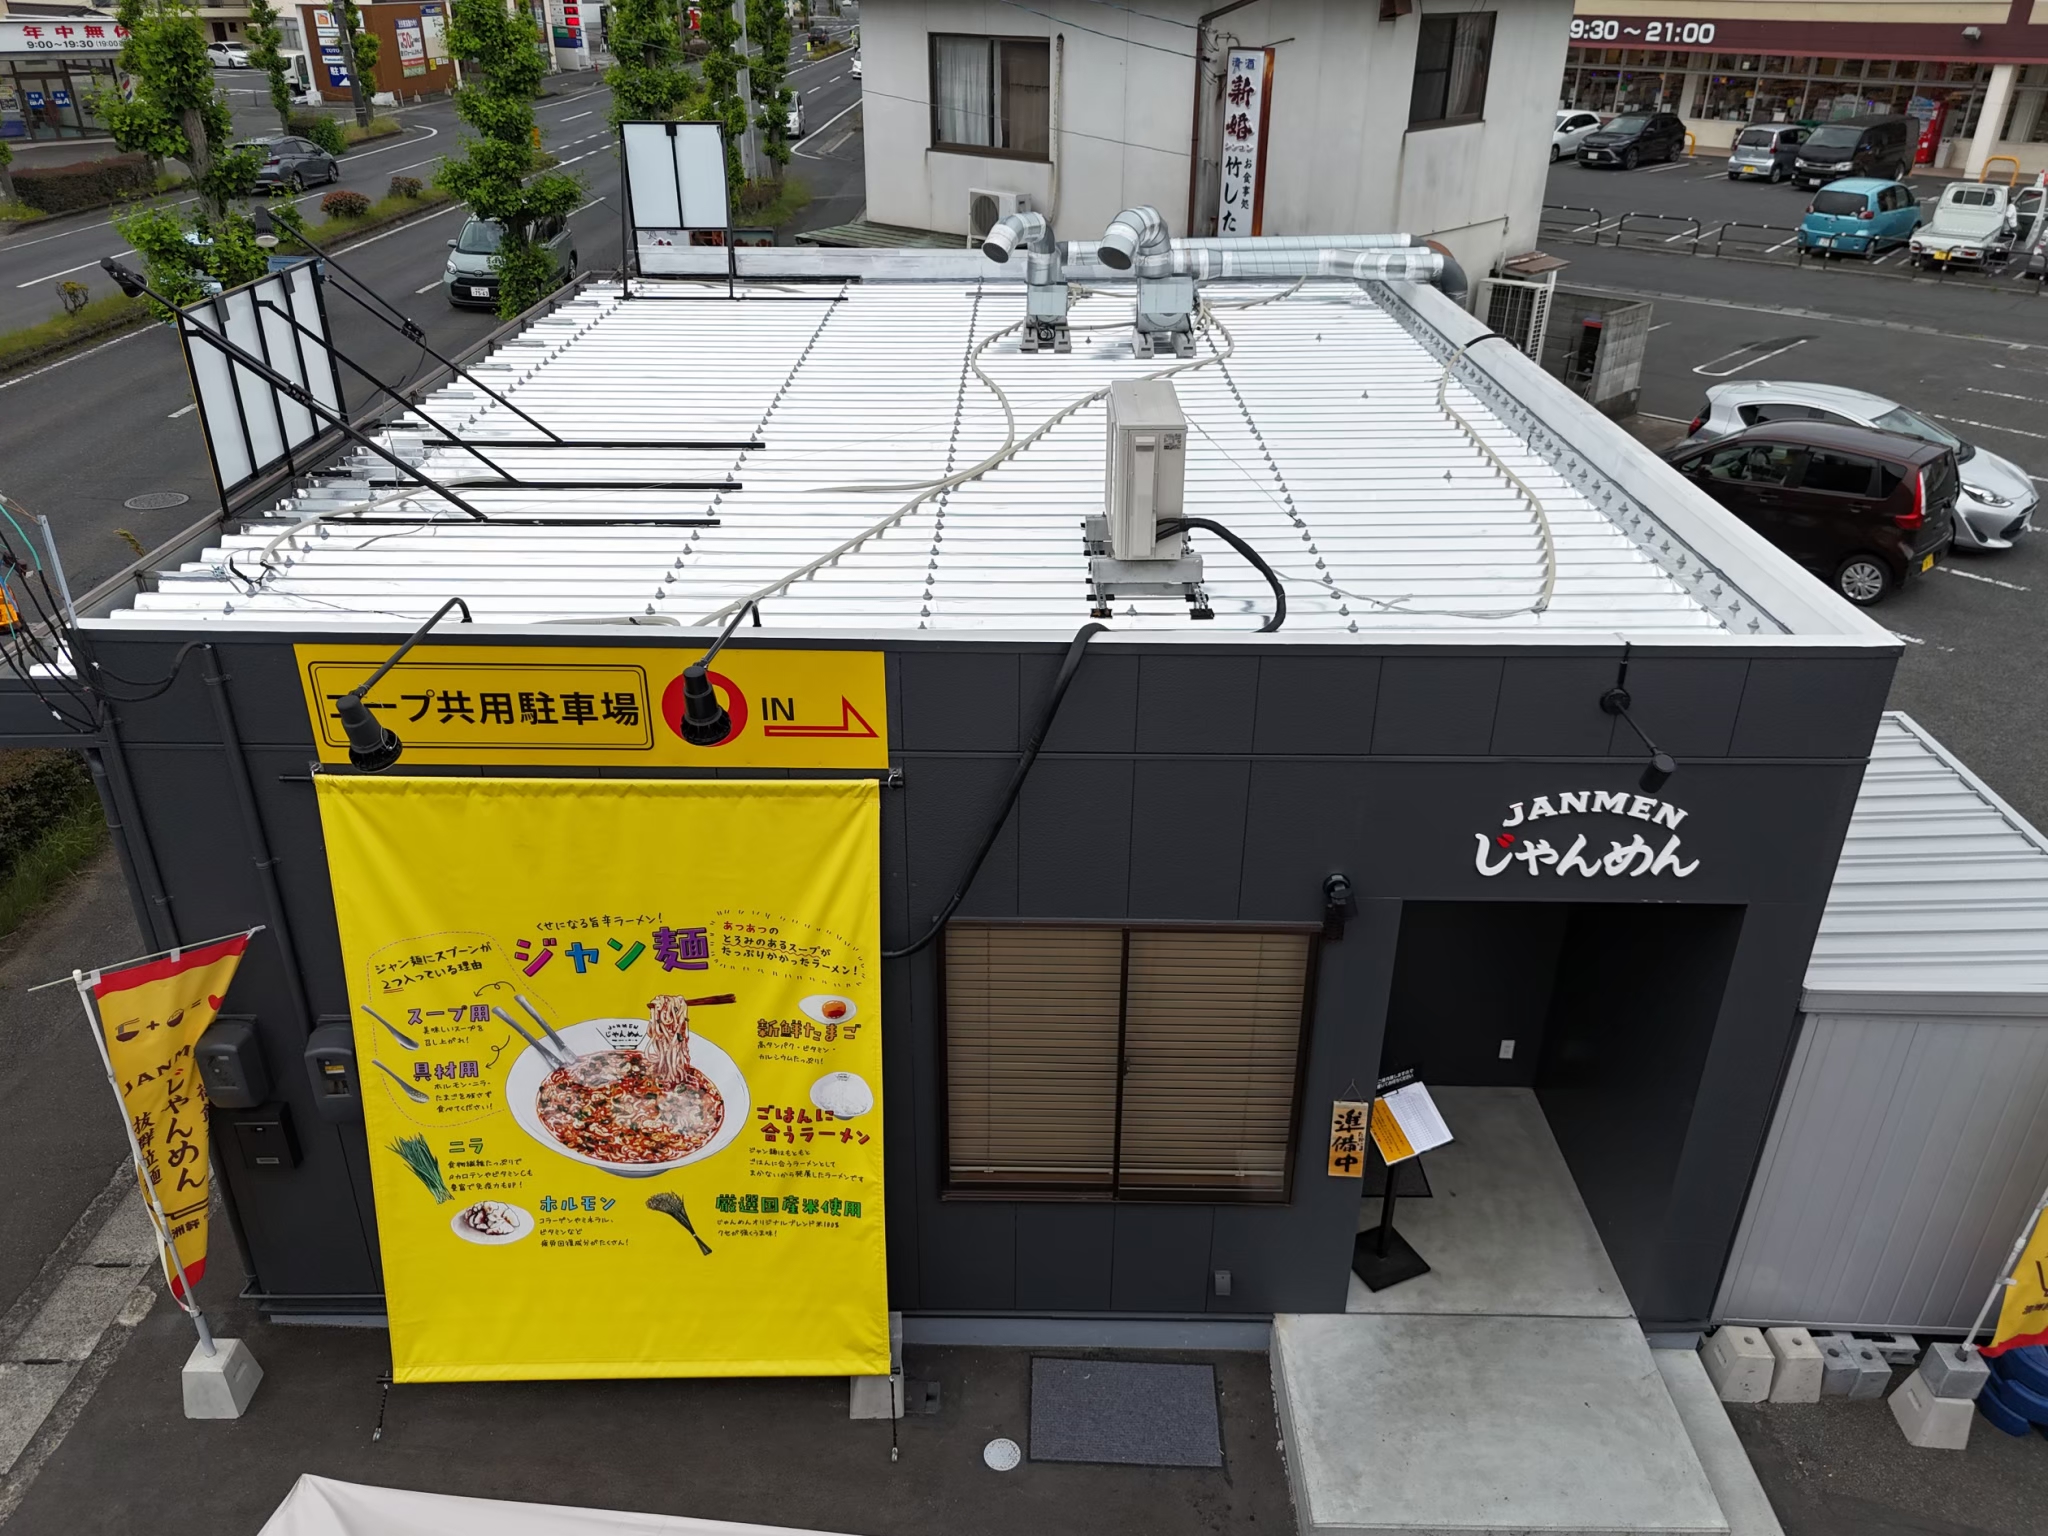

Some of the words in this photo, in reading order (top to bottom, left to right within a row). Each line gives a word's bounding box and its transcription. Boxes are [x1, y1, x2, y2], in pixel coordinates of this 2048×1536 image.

[22, 25, 131, 39] 年中無休
[27, 40, 94, 49] 9:00～19:30
[1226, 74, 1255, 140] 新婚
[1222, 155, 1242, 232] 竹した
[1240, 158, 1252, 210] お食事処
[761, 697, 795, 721] IN
[1502, 790, 1689, 830] JANMEN
[1475, 833, 1700, 878] じゃんめん
[536, 913, 663, 931] くせになる旨辛ラーメン！
[723, 921, 779, 935] あつあつの
[514, 926, 709, 977] ジャン麺
[723, 934, 831, 957] とろみのあるスープが
[375, 941, 492, 974] ジャン麺にスプーンが
[722, 946, 858, 976] たっぷりかかったラーメン！
[381, 960, 482, 989] 2つ入っている理由
[408, 1004, 490, 1025] スープ用
[423, 1025, 484, 1034] 美味しいスープを
[425, 1036, 469, 1046] 召し上がれ！
[757, 1018, 861, 1042] 新鮮たまご
[124, 1044, 195, 1098] JANM
[413, 1060, 479, 1081] 具材用
[759, 1054, 824, 1065] カルシウムたっぷり！
[437, 1103, 493, 1113] 食べてください！
[757, 1105, 834, 1123] ごはんに
[160, 1068, 206, 1192] じゃんめん
[761, 1122, 870, 1145] 合うラーメン
[1332, 1109, 1365, 1172] 準備中
[449, 1138, 483, 1154] ニラ
[750, 1158, 836, 1168] ごはんに合うラーメンとして
[540, 1195, 616, 1212] ホルモン
[715, 1194, 862, 1218] 厳選国産米使用
[540, 1228, 583, 1236] ビタミンなど
